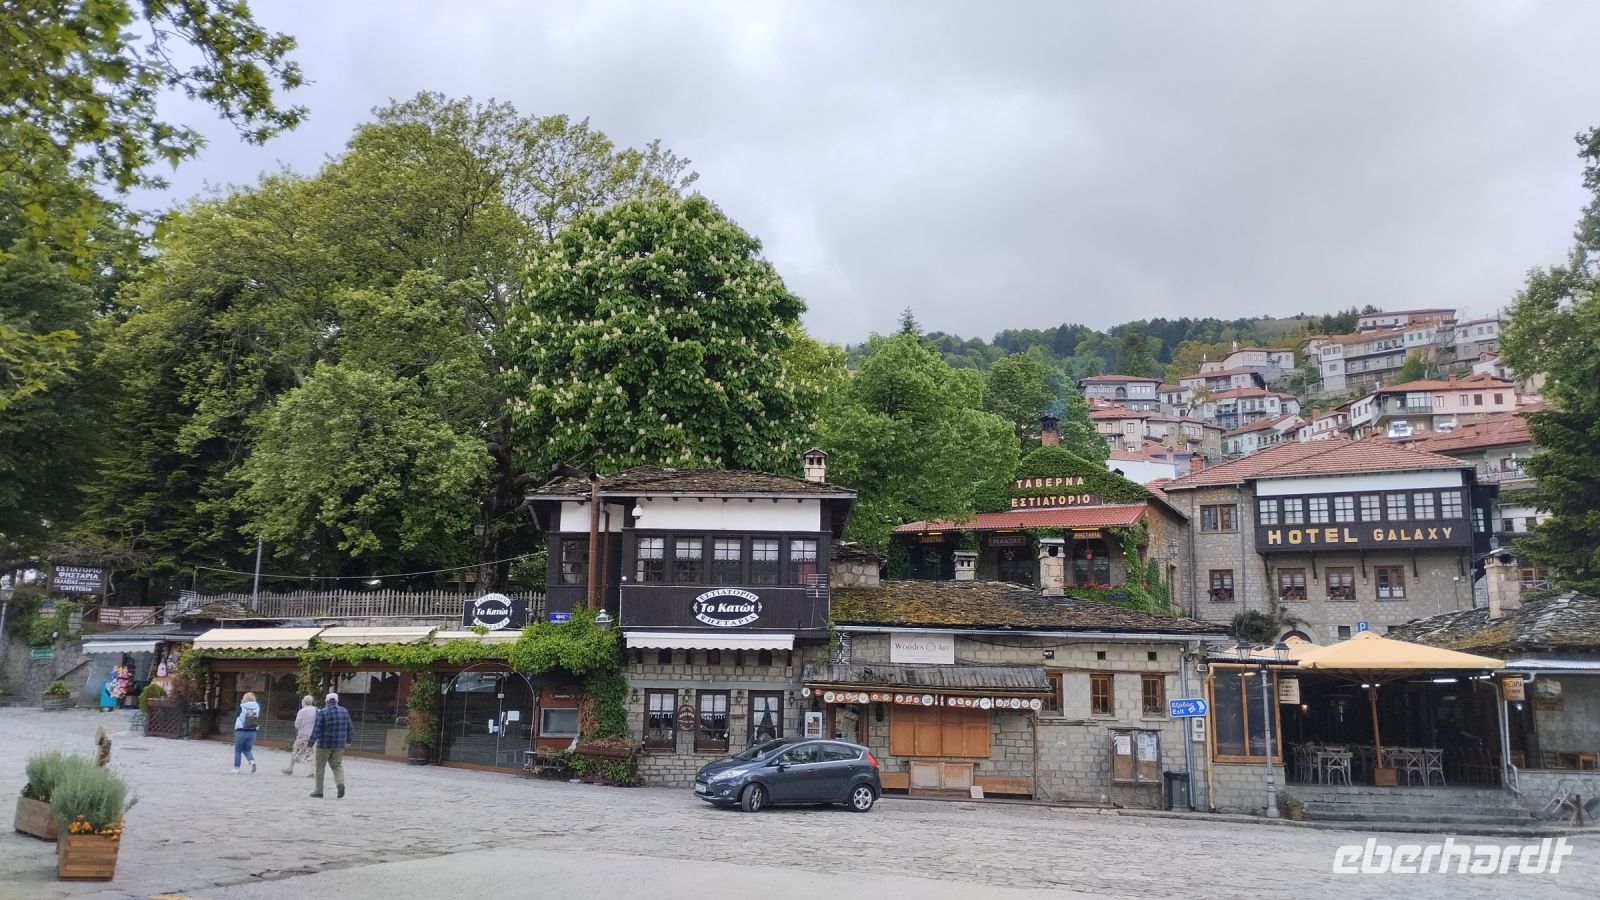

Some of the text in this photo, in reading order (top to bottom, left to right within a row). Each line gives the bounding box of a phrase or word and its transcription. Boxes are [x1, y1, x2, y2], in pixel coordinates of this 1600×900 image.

[1016, 476, 1084, 489] ΤΑΒΕΡΝΑ
[1011, 494, 1090, 507] ΕΣΤΙΑΤΟΡΙΟ
[1267, 527, 1452, 545] HOTEL GALAXY
[55, 565, 102, 574] ΕΣΤΙΑΤΟΡΙΟ
[700, 589, 756, 601] ΕΣΤΙΑΤΟΡΙΟ
[700, 615, 757, 626] ΨΗΣΤΑΡΙΑ
[1359, 622, 1367, 632] P
